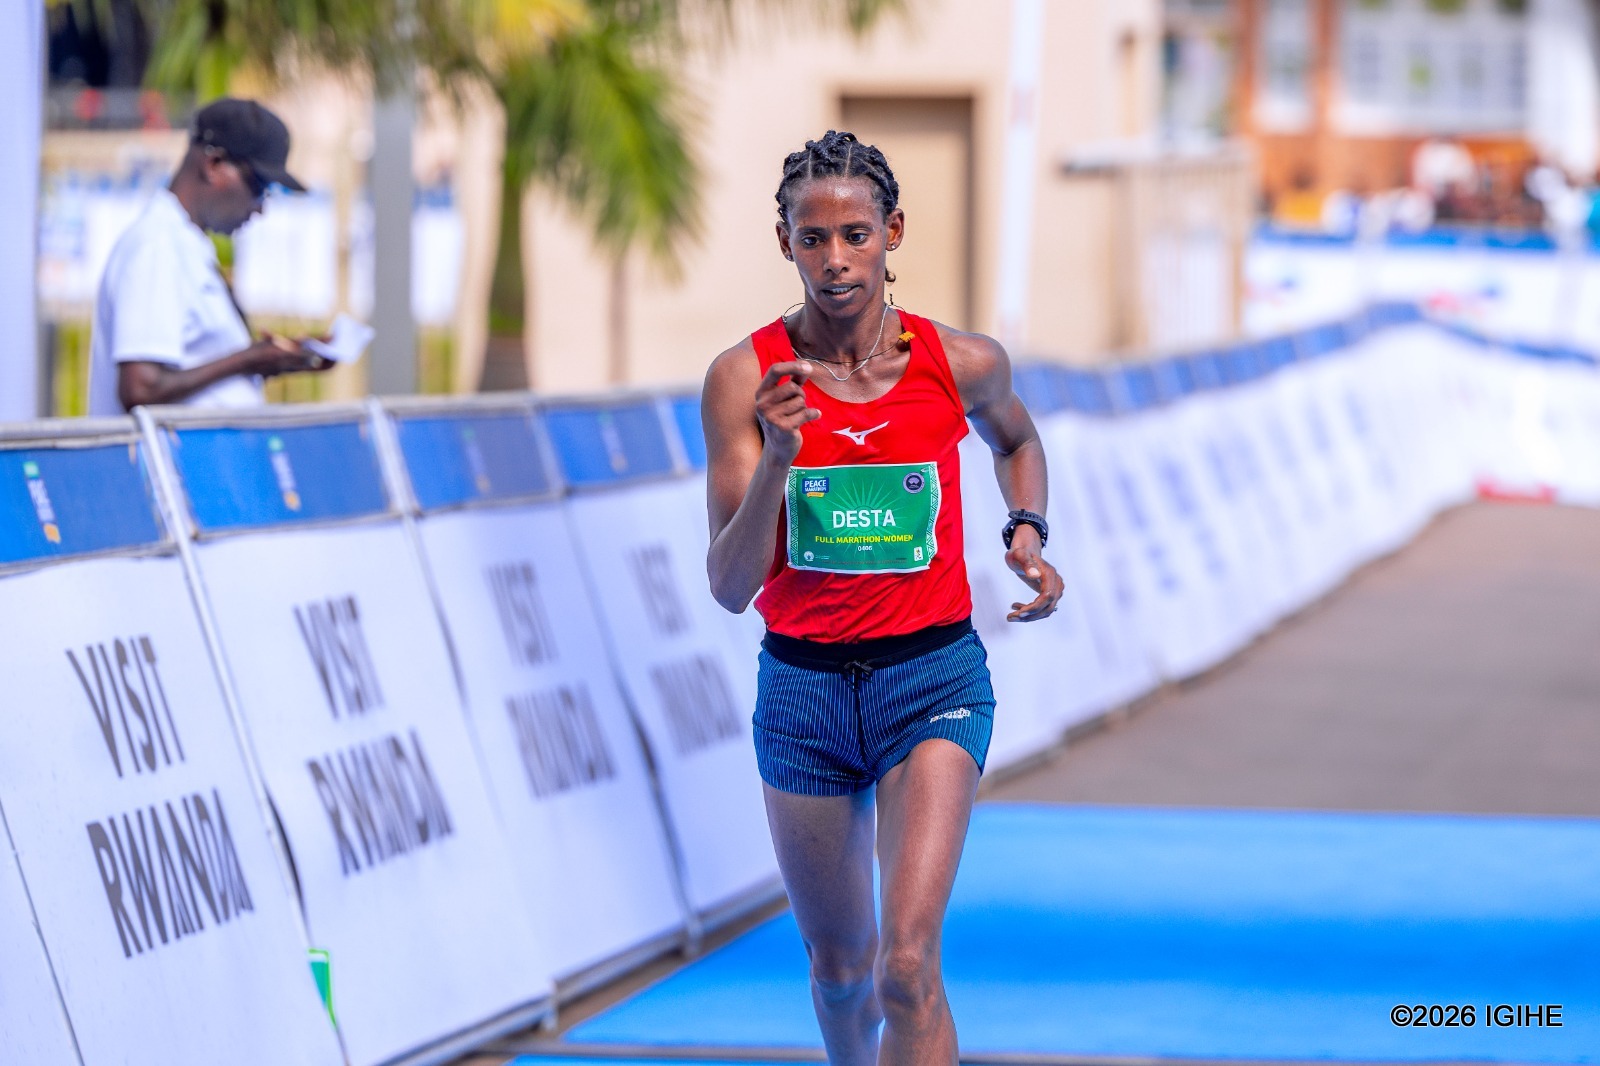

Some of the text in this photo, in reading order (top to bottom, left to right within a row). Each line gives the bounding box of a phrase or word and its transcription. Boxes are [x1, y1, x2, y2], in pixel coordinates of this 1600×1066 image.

[804, 479, 827, 487] PEACE
[815, 534, 914, 544] FULL MARATHON-WOMEN
[832, 509, 896, 528] DESTA
[66, 636, 186, 778] VISIT
[292, 596, 385, 720] VISIT
[307, 726, 454, 878] RWANDA
[86, 788, 255, 959] RWANDA
